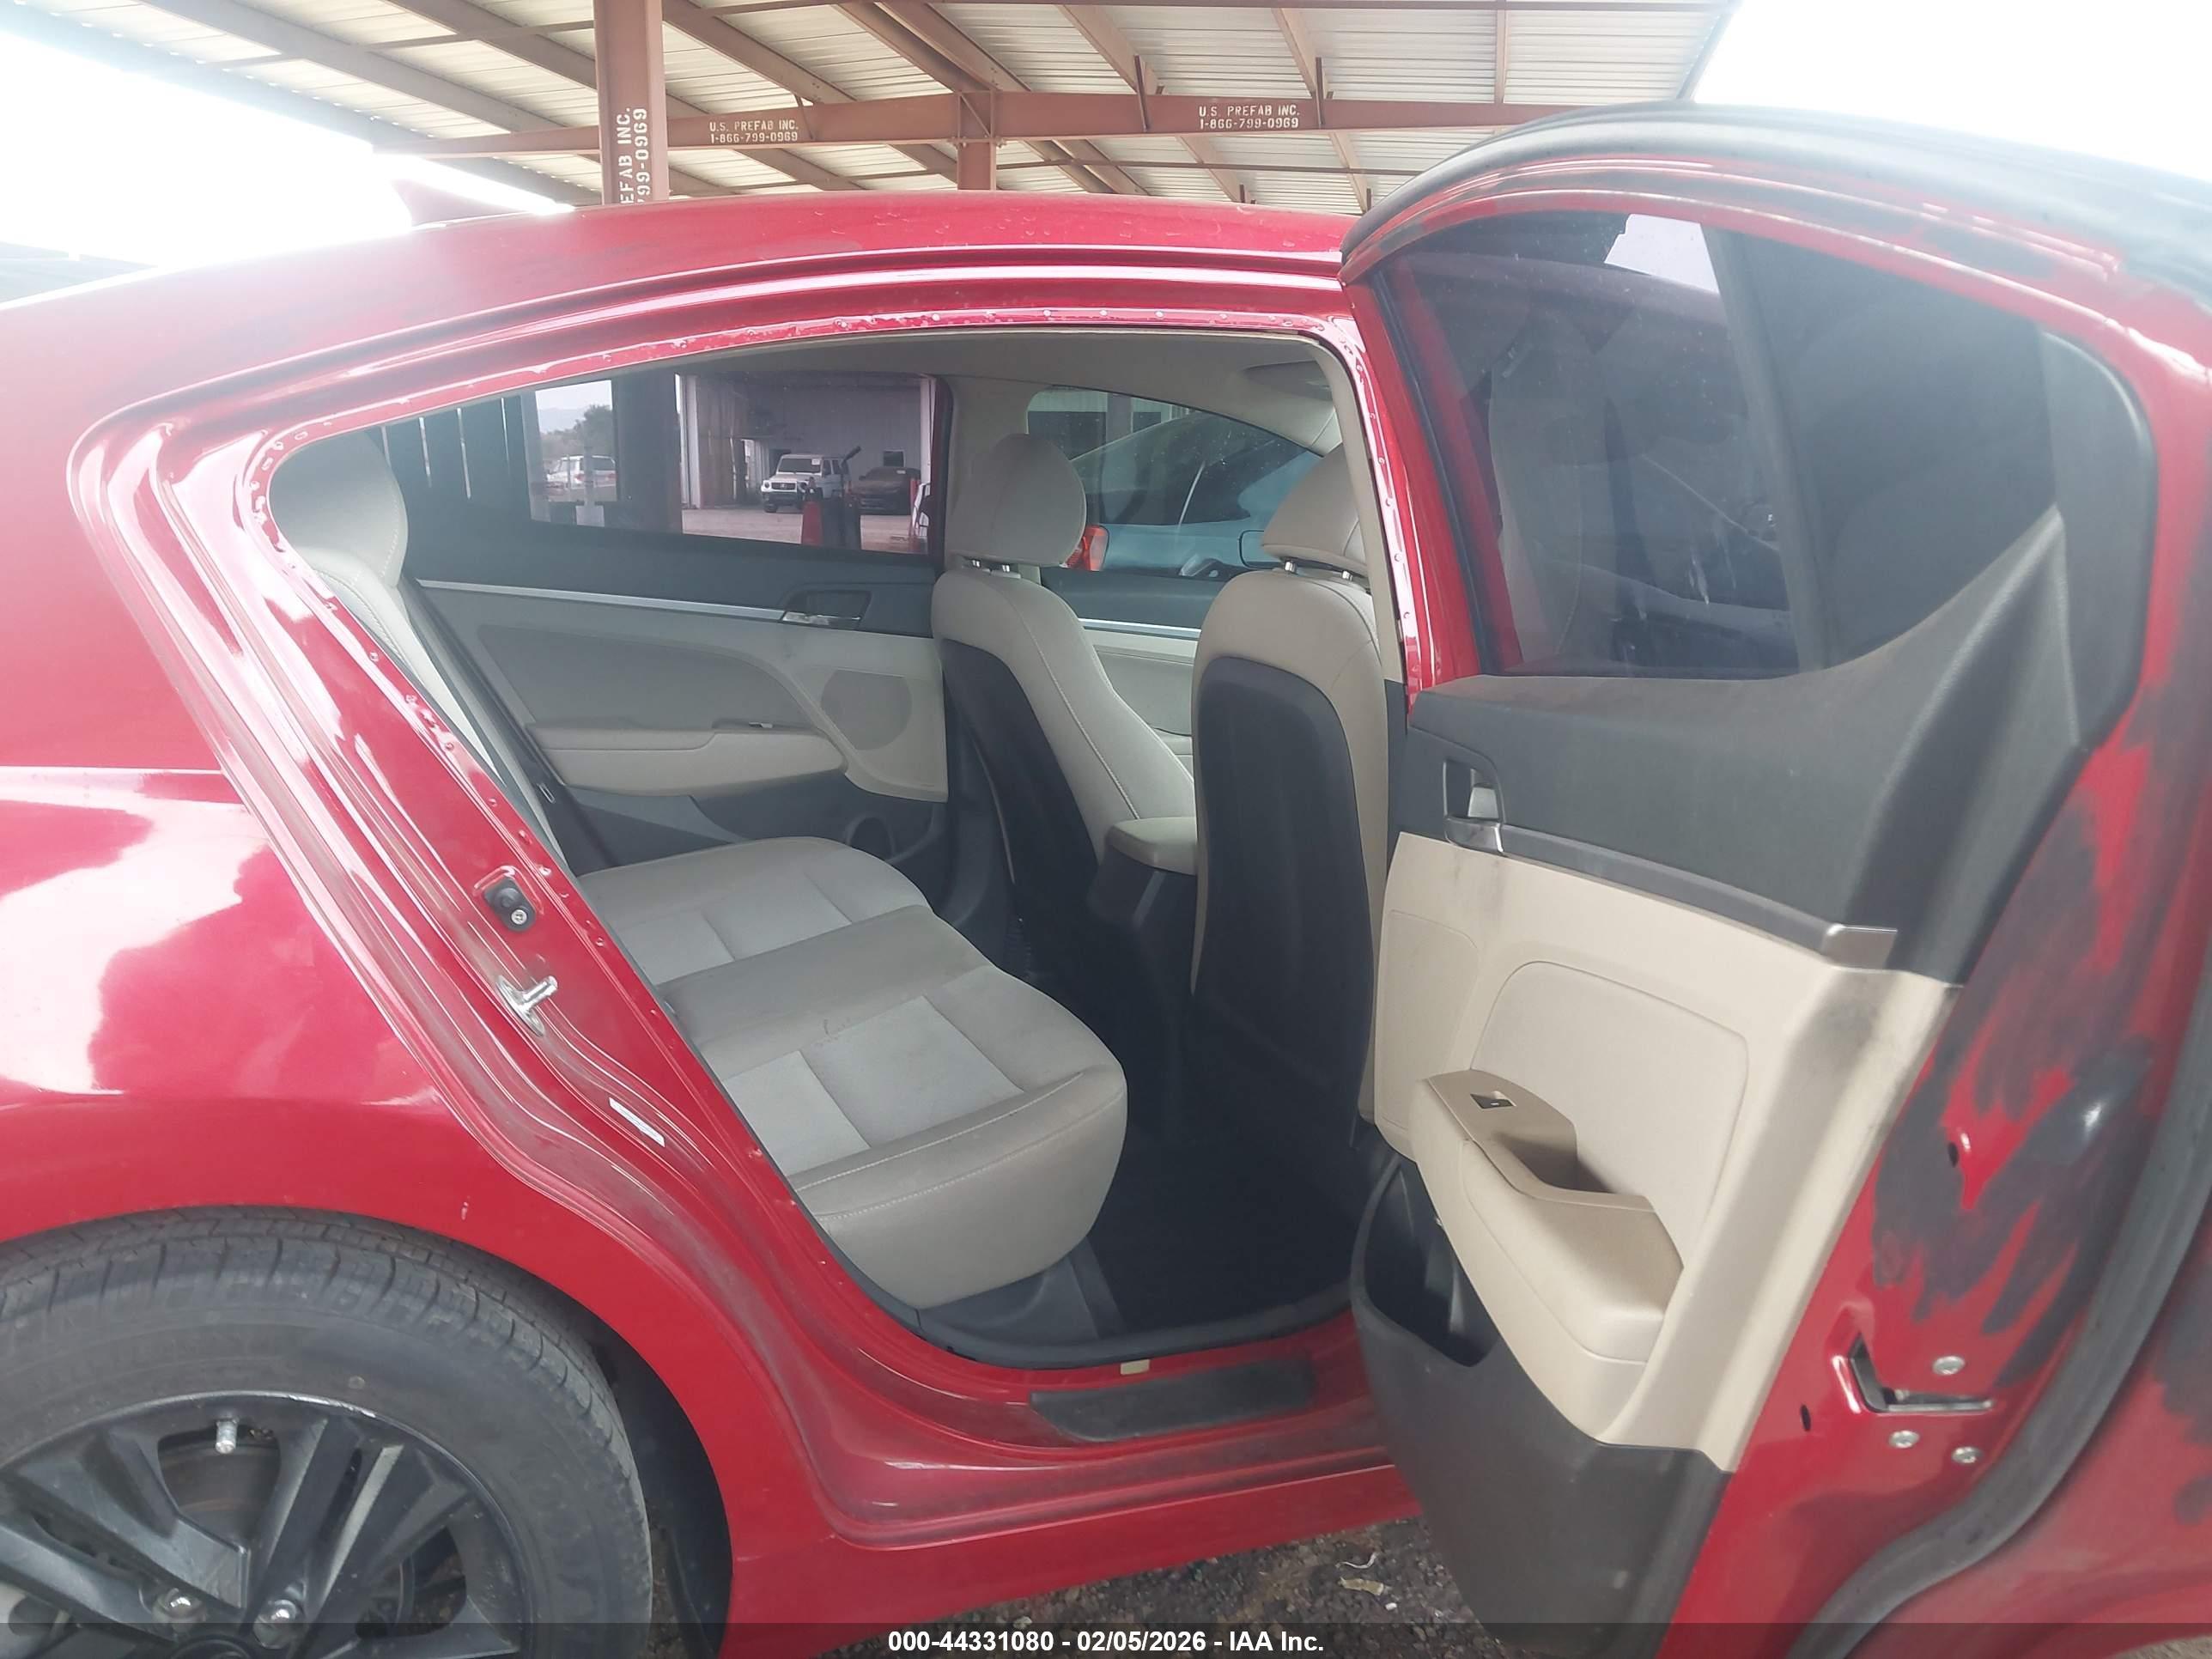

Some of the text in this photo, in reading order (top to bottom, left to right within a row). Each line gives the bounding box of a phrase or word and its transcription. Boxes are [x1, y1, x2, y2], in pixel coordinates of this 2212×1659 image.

[1227, 105, 1273, 117] PREFAB
[1278, 105, 1300, 116] INC.
[617, 107, 632, 144] INC.
[708, 119, 799, 132] U.S. PREFAB INC.
[1200, 118, 1299, 130] 1-866-799-0969
[710, 131, 798, 143] 1-866-799-0969
